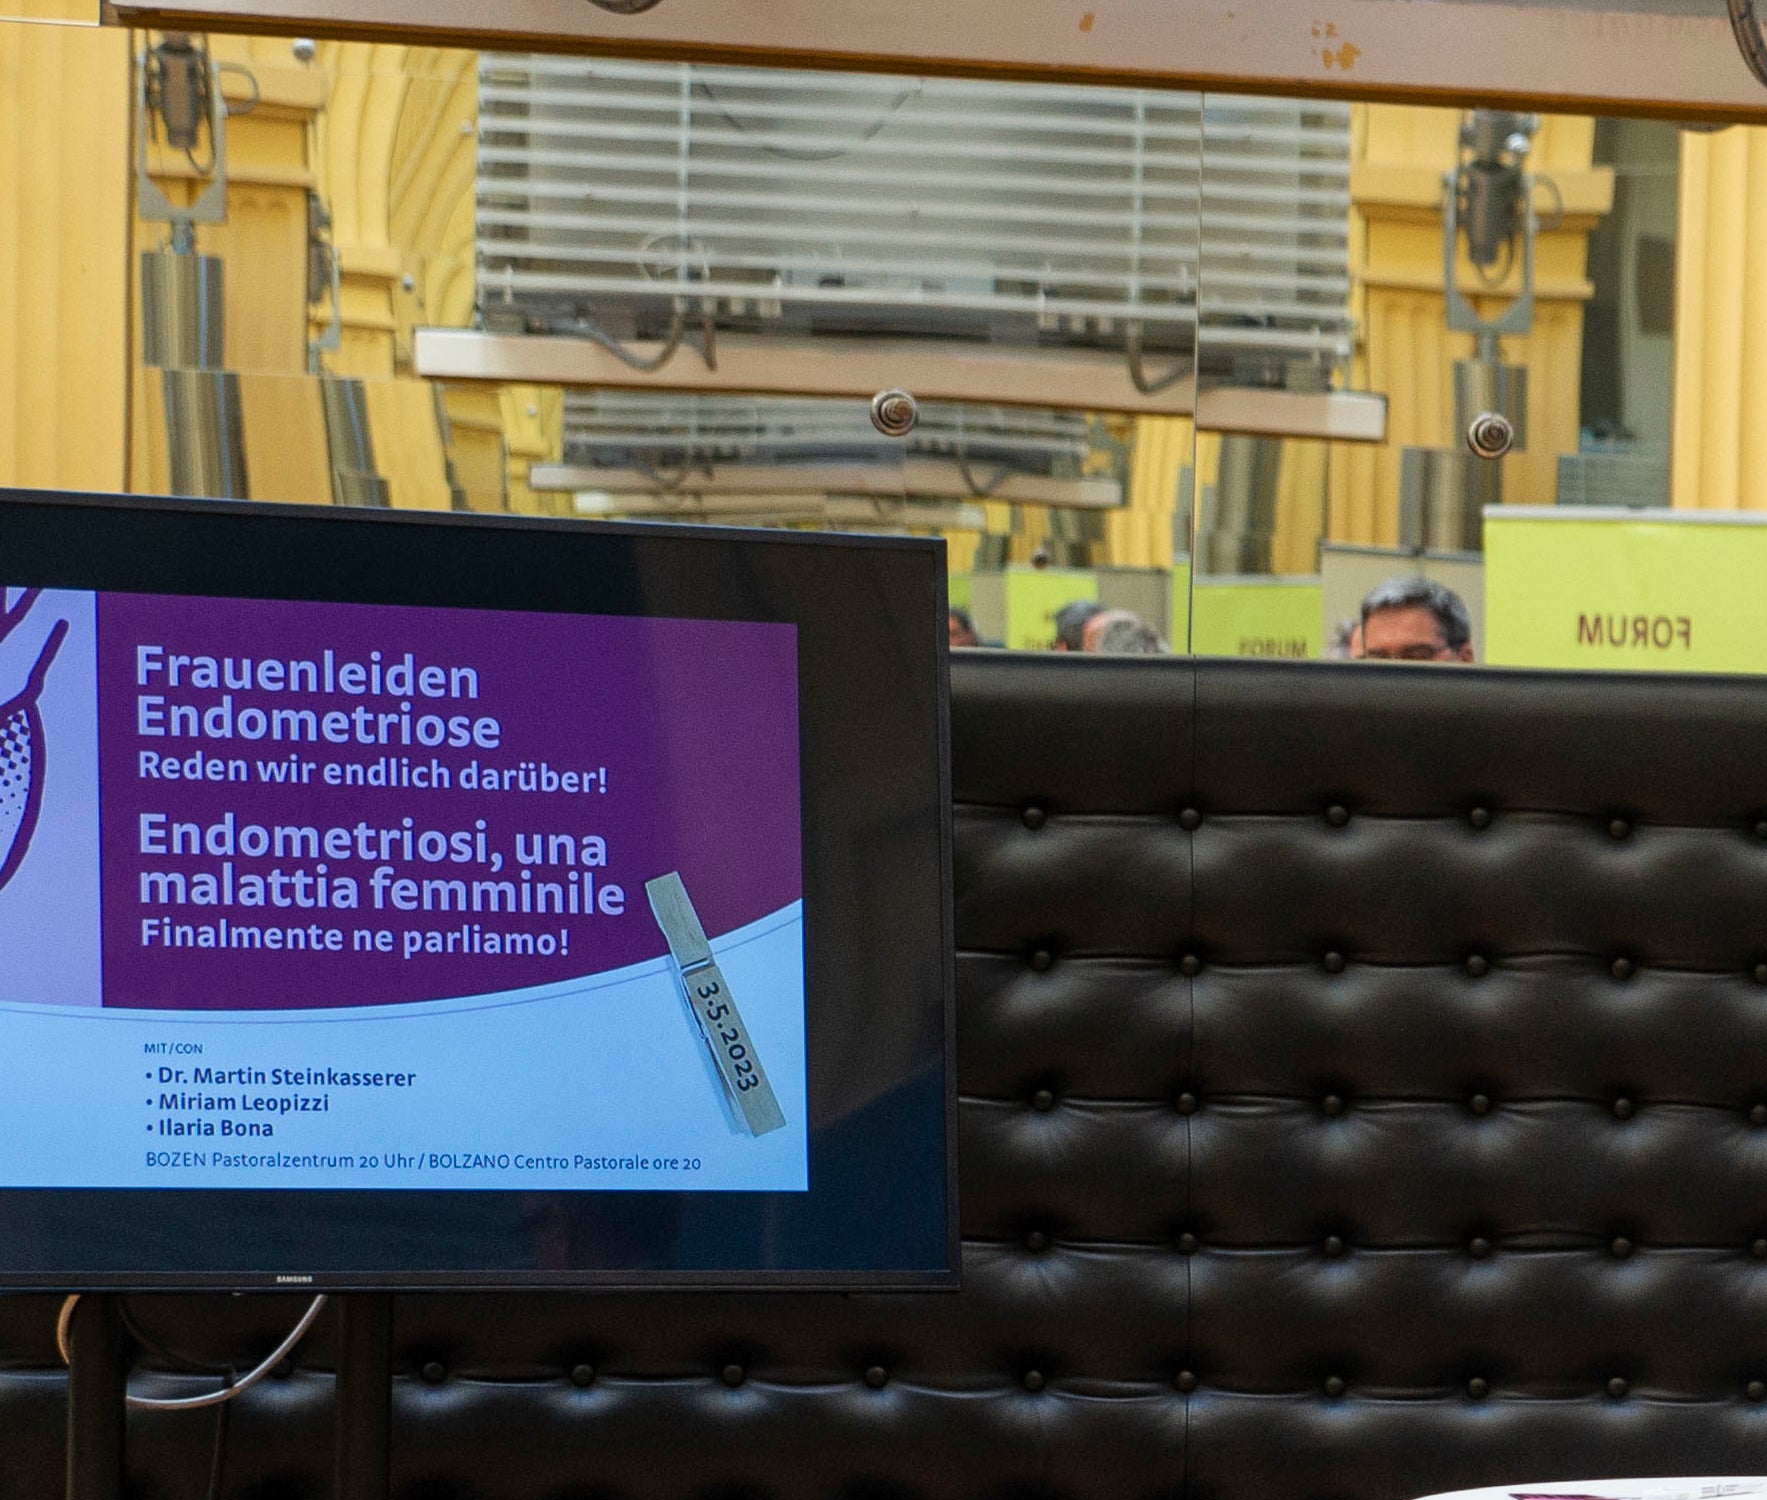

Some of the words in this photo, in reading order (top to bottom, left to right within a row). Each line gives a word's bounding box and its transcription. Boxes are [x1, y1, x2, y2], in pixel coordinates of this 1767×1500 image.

[136, 645, 479, 698] Frauenleiden
[137, 695, 501, 749] Endometriose
[139, 750, 249, 782] Reden
[256, 753, 317, 785] wir
[323, 757, 451, 789] endlich
[459, 761, 607, 794] darüber!
[139, 812, 503, 872] Endometriosi,
[515, 831, 608, 867] una
[139, 862, 359, 910] malattia
[369, 866, 626, 916] femminile
[141, 916, 344, 953] Finalmente
[353, 928, 394, 953] ne
[403, 925, 570, 960] parliamo!
[144, 1042, 203, 1055] MIT/CON
[696, 981, 760, 1094] 3.5.2023
[158, 1066, 188, 1084] Dr.
[194, 1066, 266, 1086] Martin
[271, 1067, 417, 1087] Steinkasserer
[159, 1092, 236, 1111] Miriam
[242, 1093, 330, 1115] Leopizzi
[159, 1118, 215, 1136] Ilaria
[221, 1119, 274, 1137] Bona
[146, 1152, 206, 1168] BOZEN
[212, 1152, 354, 1169] Pastoralzentrum
[359, 1155, 379, 1169] 20
[384, 1154, 415, 1169] Uhr
[429, 1154, 510, 1170] BOLZANO
[514, 1154, 569, 1170] Centro
[574, 1154, 649, 1171] Pastorale
[652, 1158, 678, 1171] ore
[682, 1158, 701, 1171] 20
